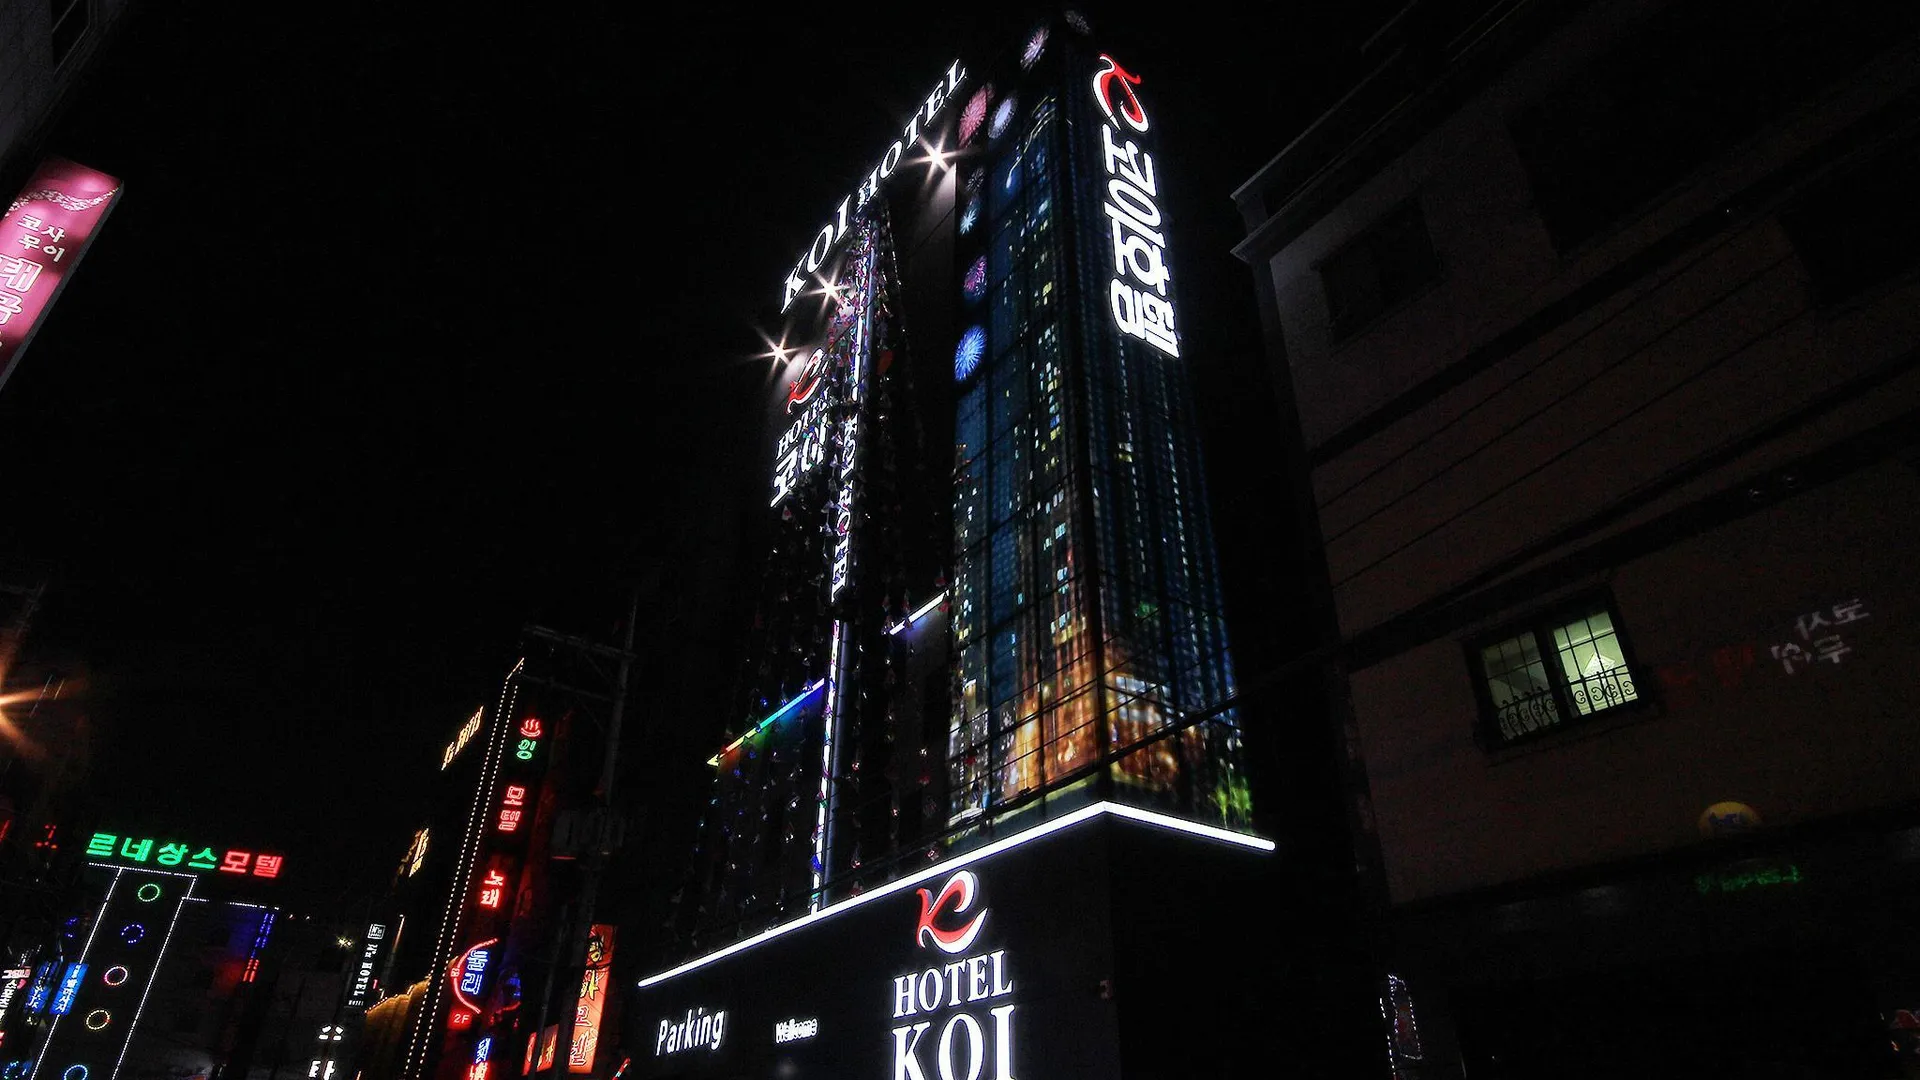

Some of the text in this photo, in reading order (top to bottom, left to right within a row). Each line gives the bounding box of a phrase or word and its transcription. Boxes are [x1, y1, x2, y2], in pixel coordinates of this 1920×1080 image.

[780, 58, 967, 314] KOI HOTEL
[499, 785, 525, 831] 모텔
[480, 869, 505, 908] 노래
[893, 949, 1015, 1018] HOTEL
[453, 1013, 471, 1025] 2F
[655, 1007, 726, 1057] Parking
[891, 1004, 1015, 1080] KOI
